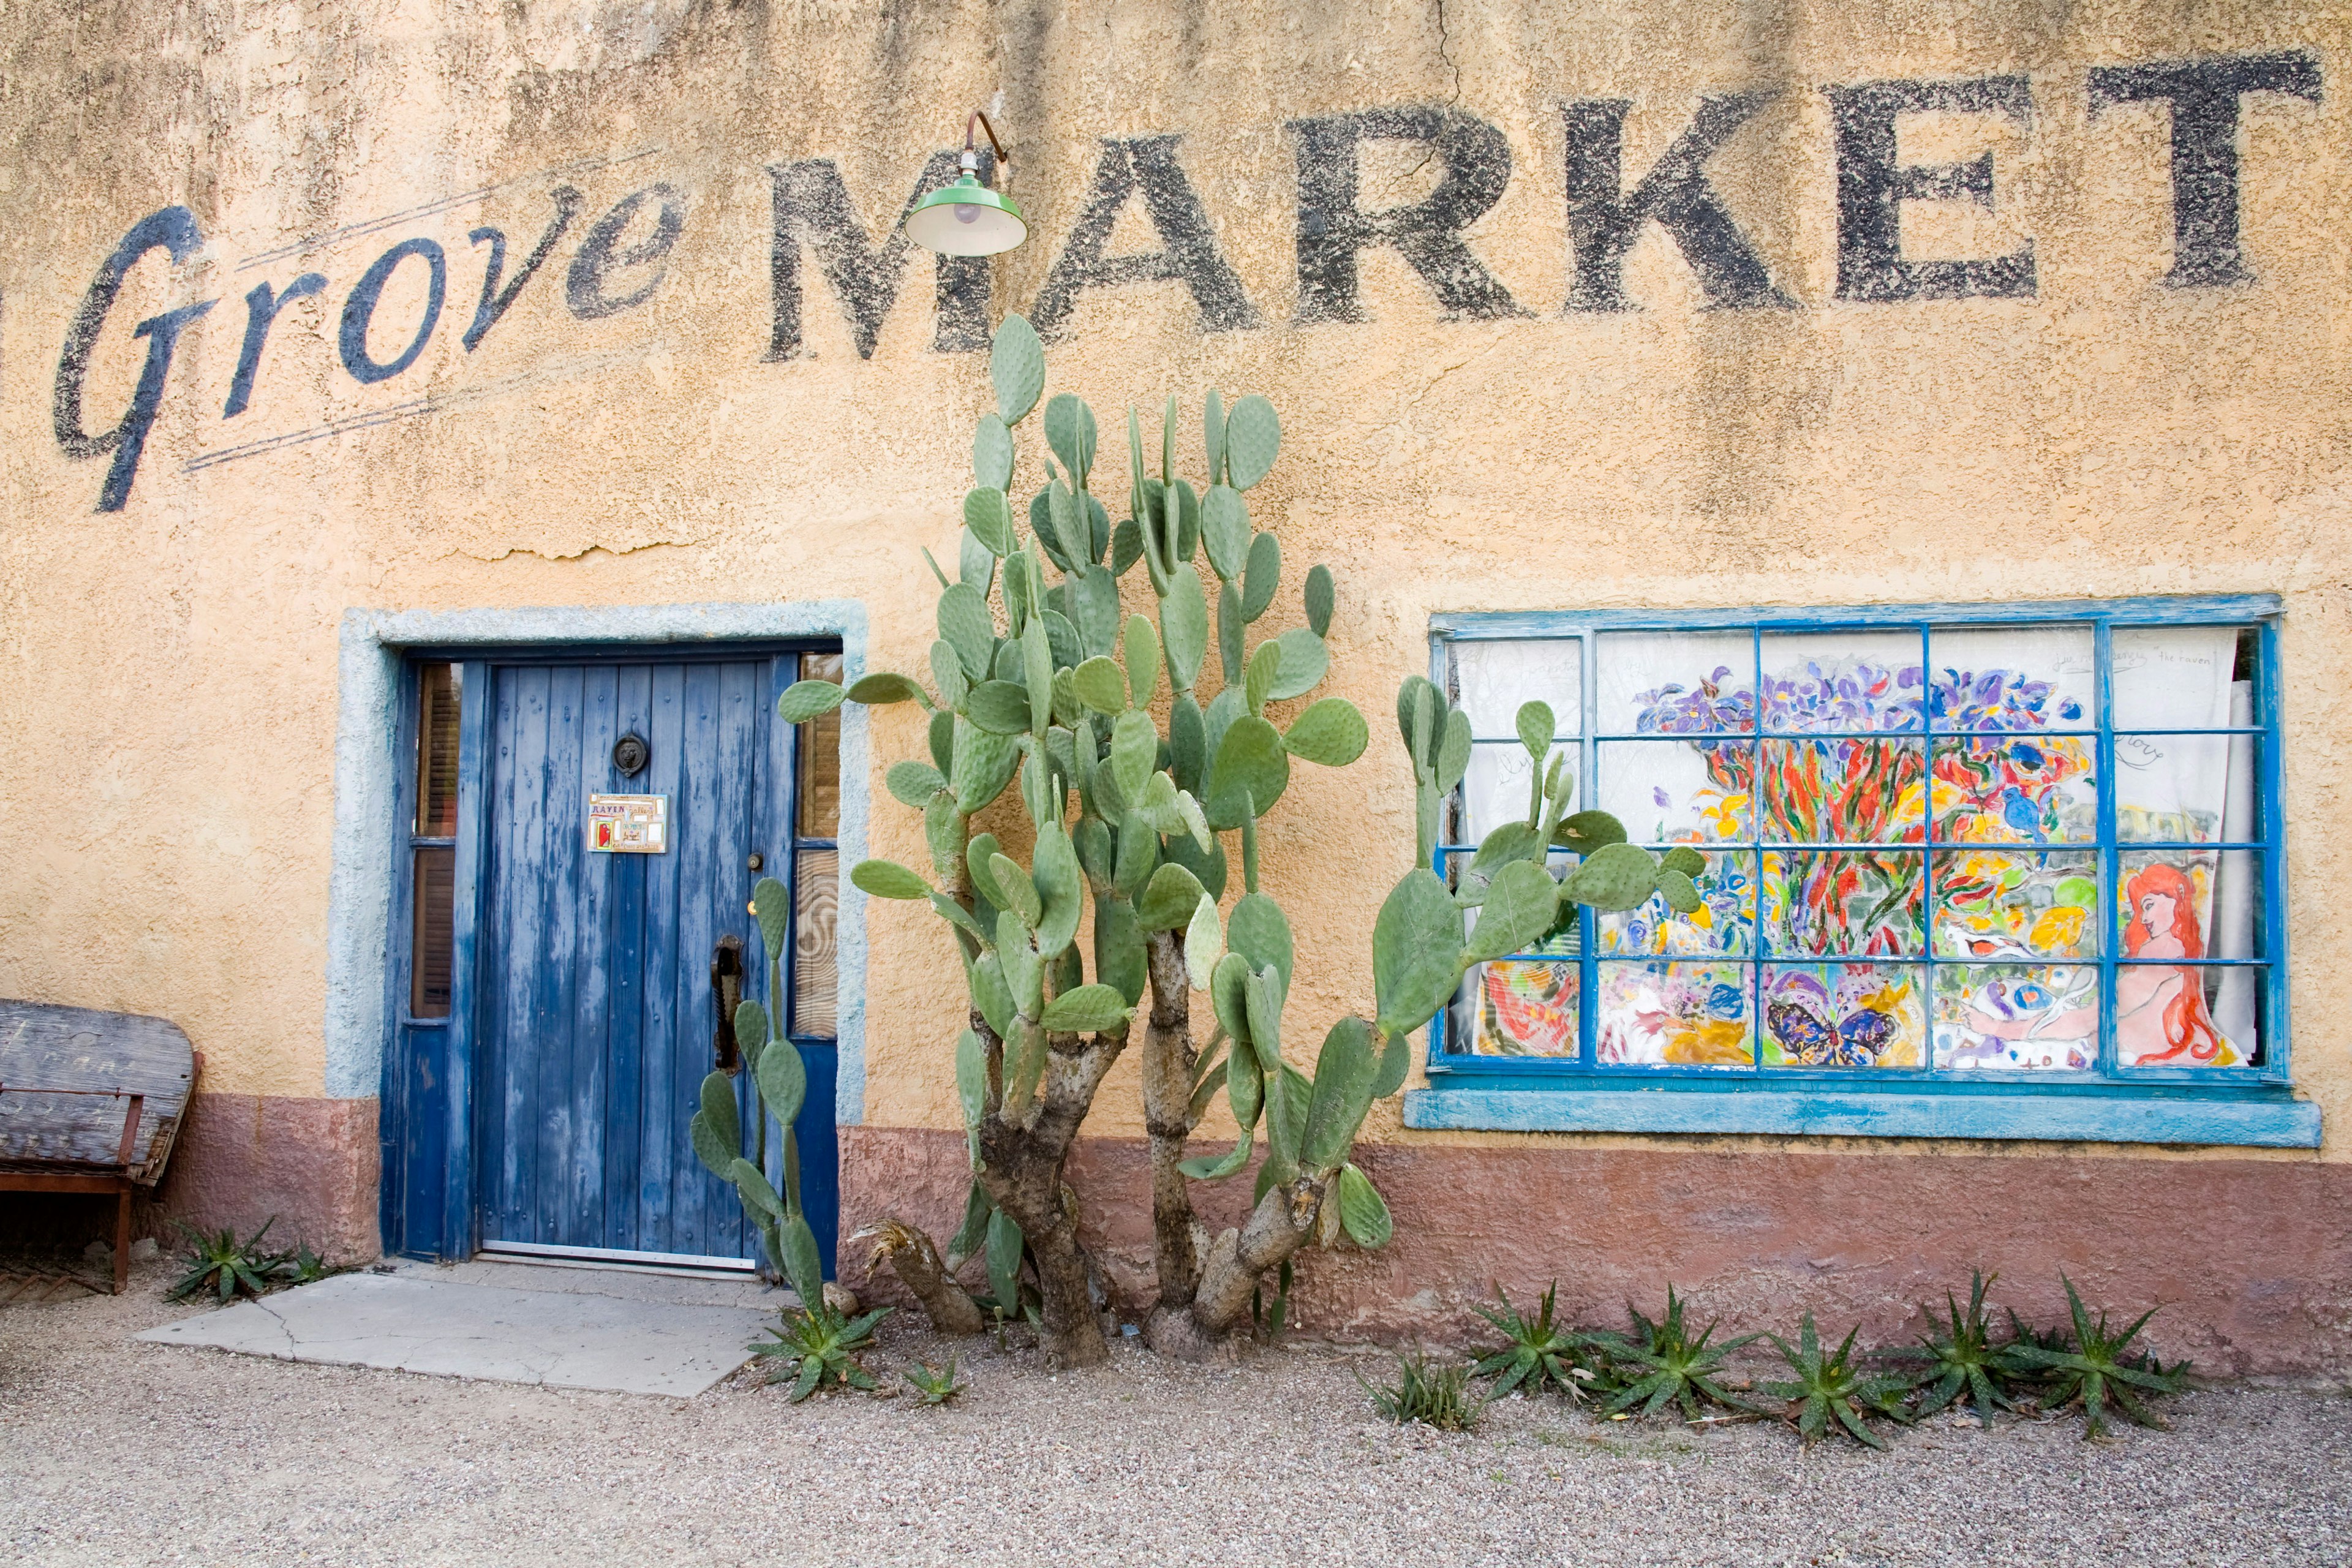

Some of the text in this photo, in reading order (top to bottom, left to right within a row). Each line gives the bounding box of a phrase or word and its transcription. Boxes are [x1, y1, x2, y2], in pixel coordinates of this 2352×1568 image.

[53, 48, 2324, 513] Grove MARKET
[629, 806, 654, 819] gallery
